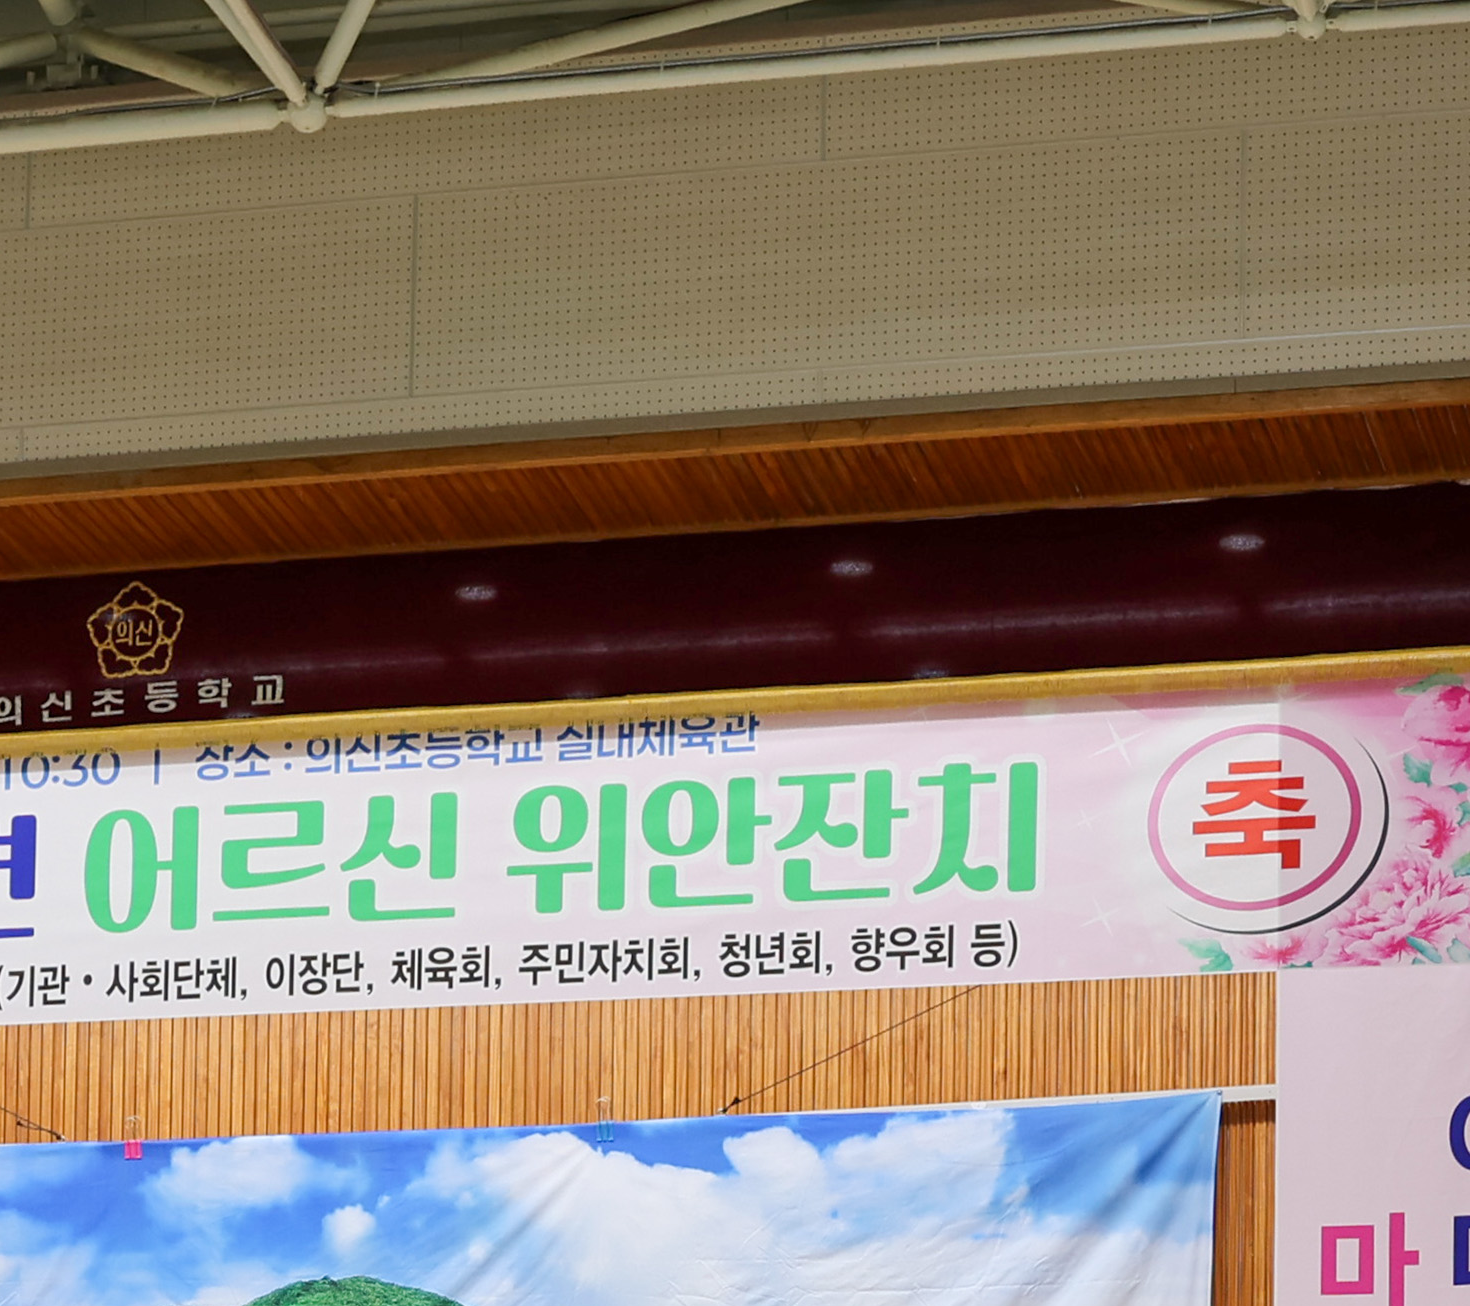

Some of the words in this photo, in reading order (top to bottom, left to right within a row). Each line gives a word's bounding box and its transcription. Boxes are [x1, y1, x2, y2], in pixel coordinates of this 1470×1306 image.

[115, 618, 155, 648] 의신
[304, 724, 544, 777] 의신초등학교
[555, 708, 762, 765] 실내체육관
[83, 791, 460, 934] 어르신
[506, 760, 1041, 916] 위안잔치
[1190, 758, 1317, 871] 축
[264, 950, 375, 997] 이장단,
[390, 943, 502, 990] 체육회,
[516, 934, 702, 986] 주민자치회,
[717, 927, 834, 980] 청년회,
[850, 921, 955, 975] 향우회
[969, 917, 1019, 968] 등)
